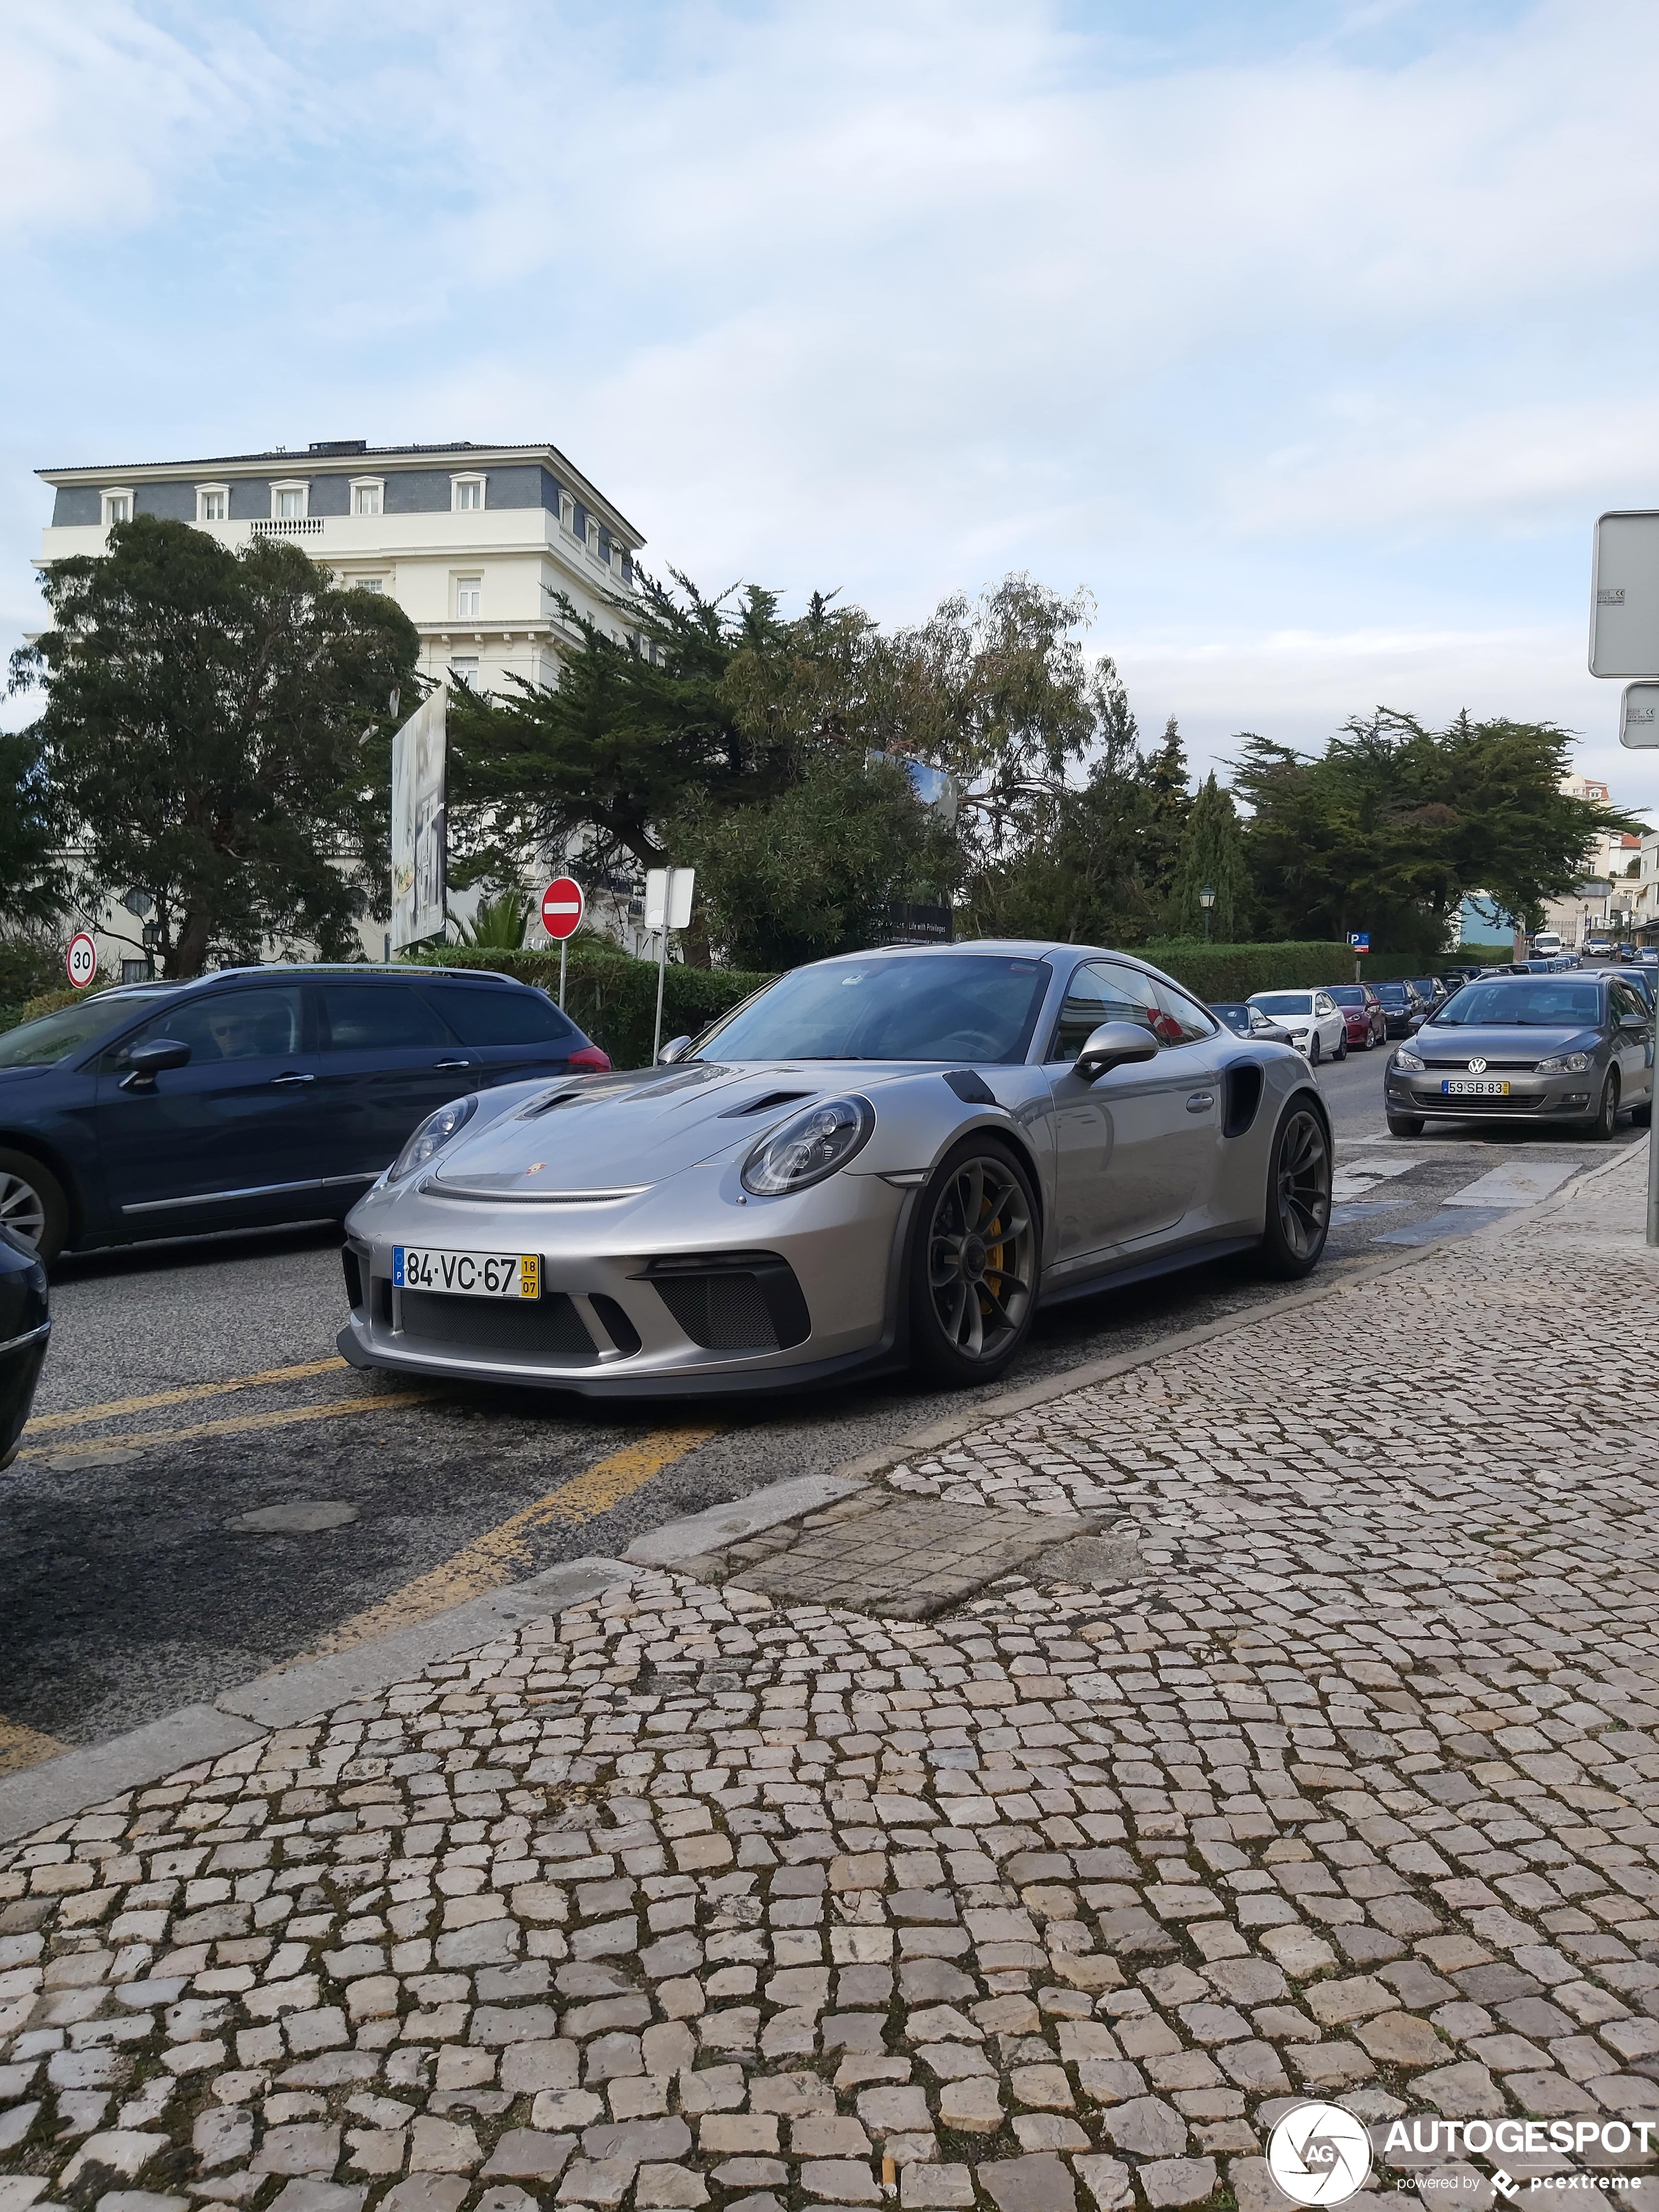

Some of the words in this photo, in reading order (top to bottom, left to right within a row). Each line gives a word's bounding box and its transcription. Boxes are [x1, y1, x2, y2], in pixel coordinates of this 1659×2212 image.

[926, 923, 946, 934] Privileges
[1351, 934, 1359, 944] P
[74, 951, 90, 969] 30
[524, 1260, 536, 1272] 18
[396, 1271, 402, 1280] P
[523, 1281, 536, 1293] 07
